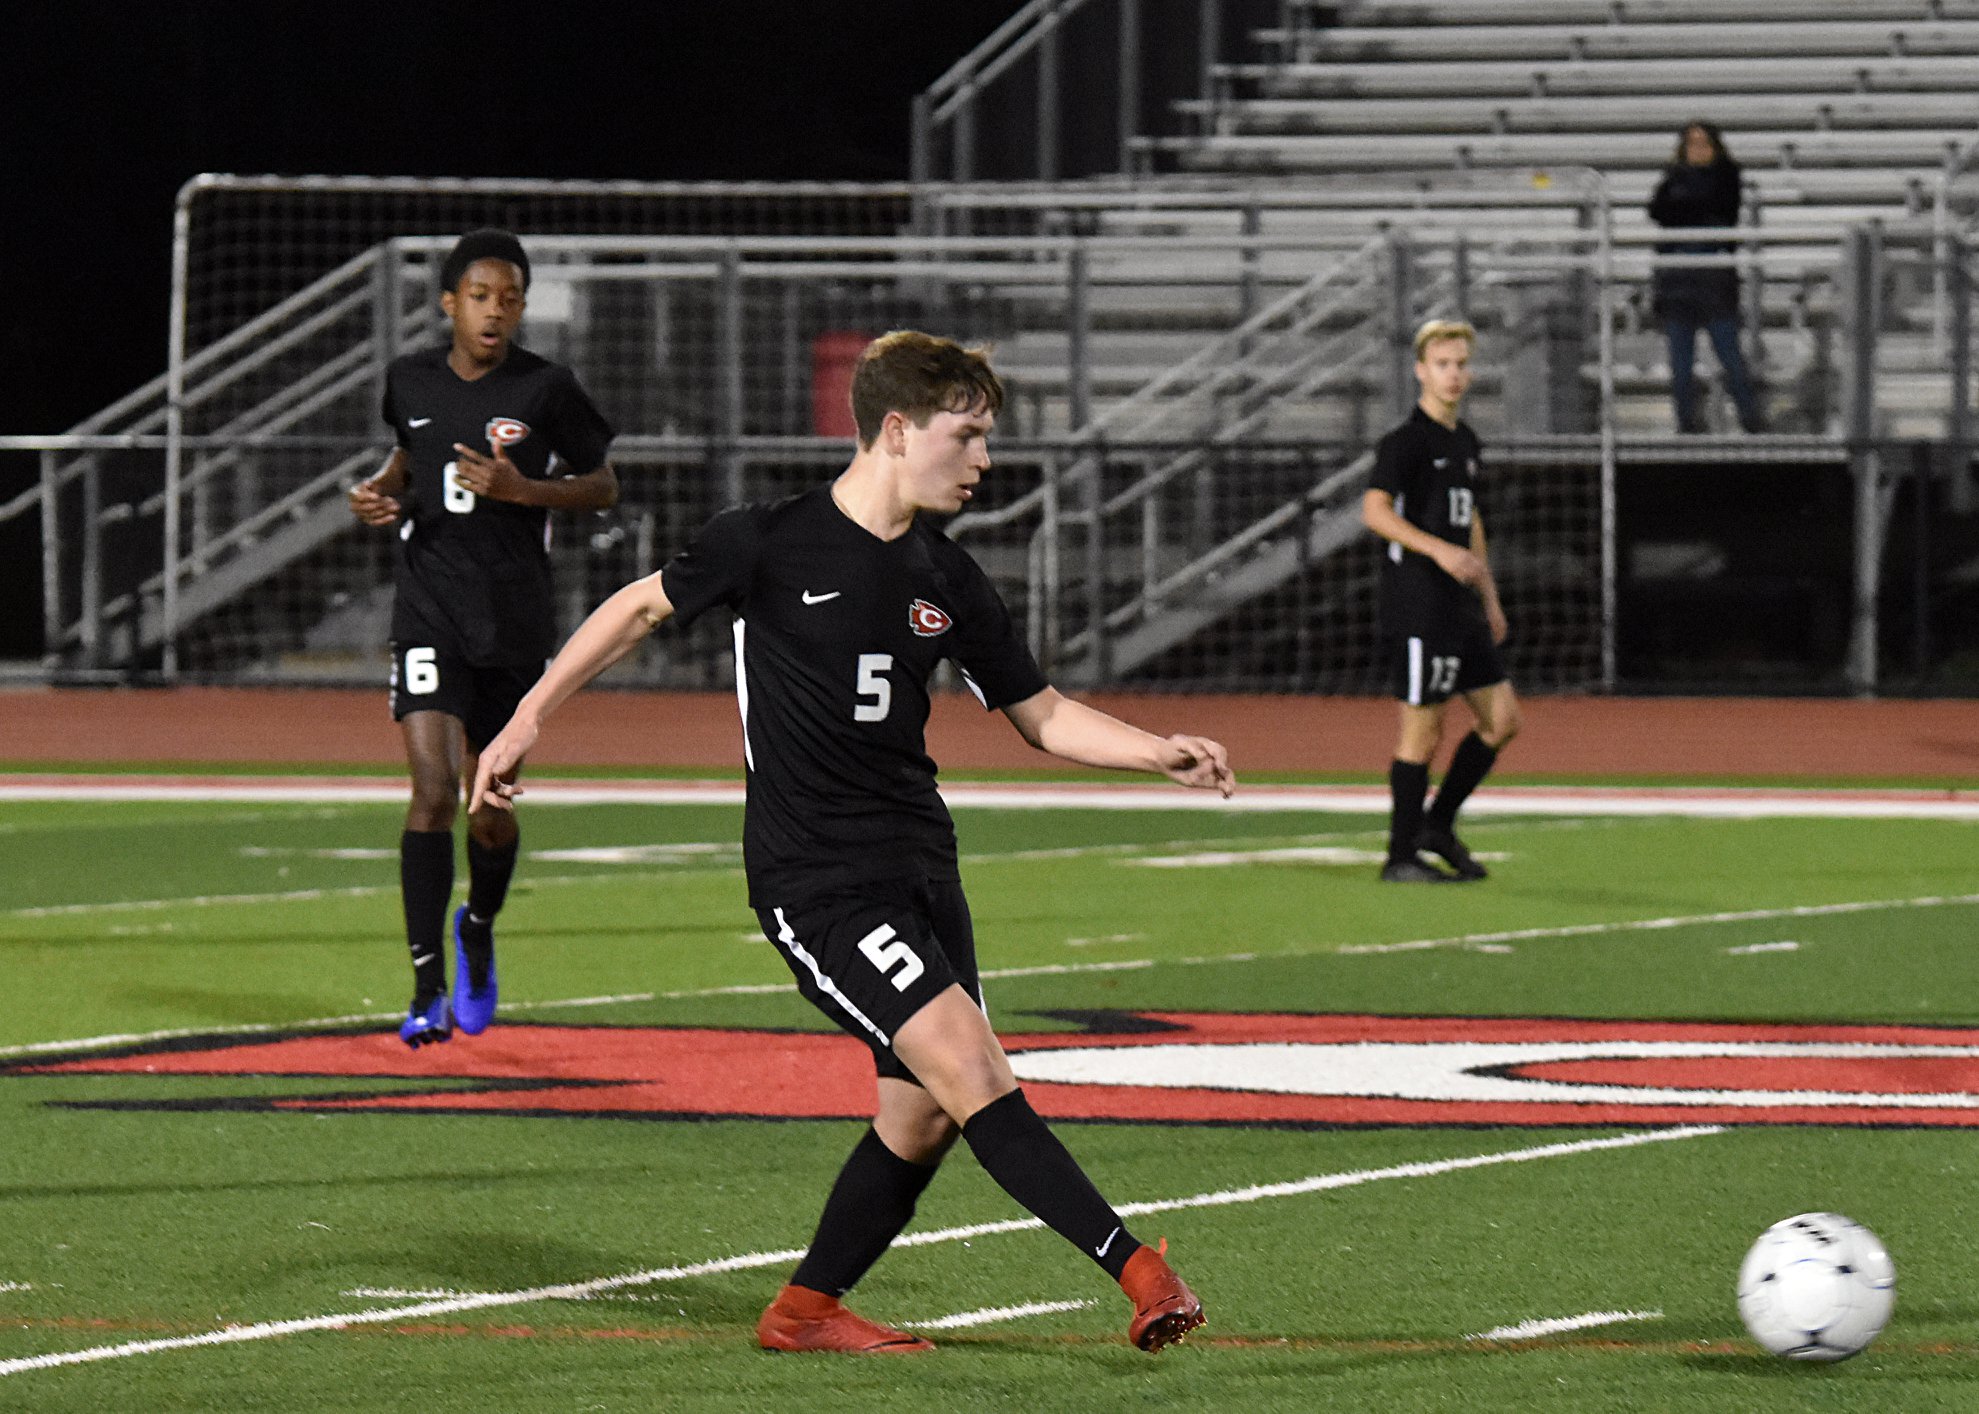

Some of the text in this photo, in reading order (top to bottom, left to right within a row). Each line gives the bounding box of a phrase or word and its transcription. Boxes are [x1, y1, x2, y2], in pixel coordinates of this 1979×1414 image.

[919, 608, 943, 629] C
[405, 647, 438, 695] 6
[854, 654, 893, 722] 5
[857, 923, 924, 992] 5
